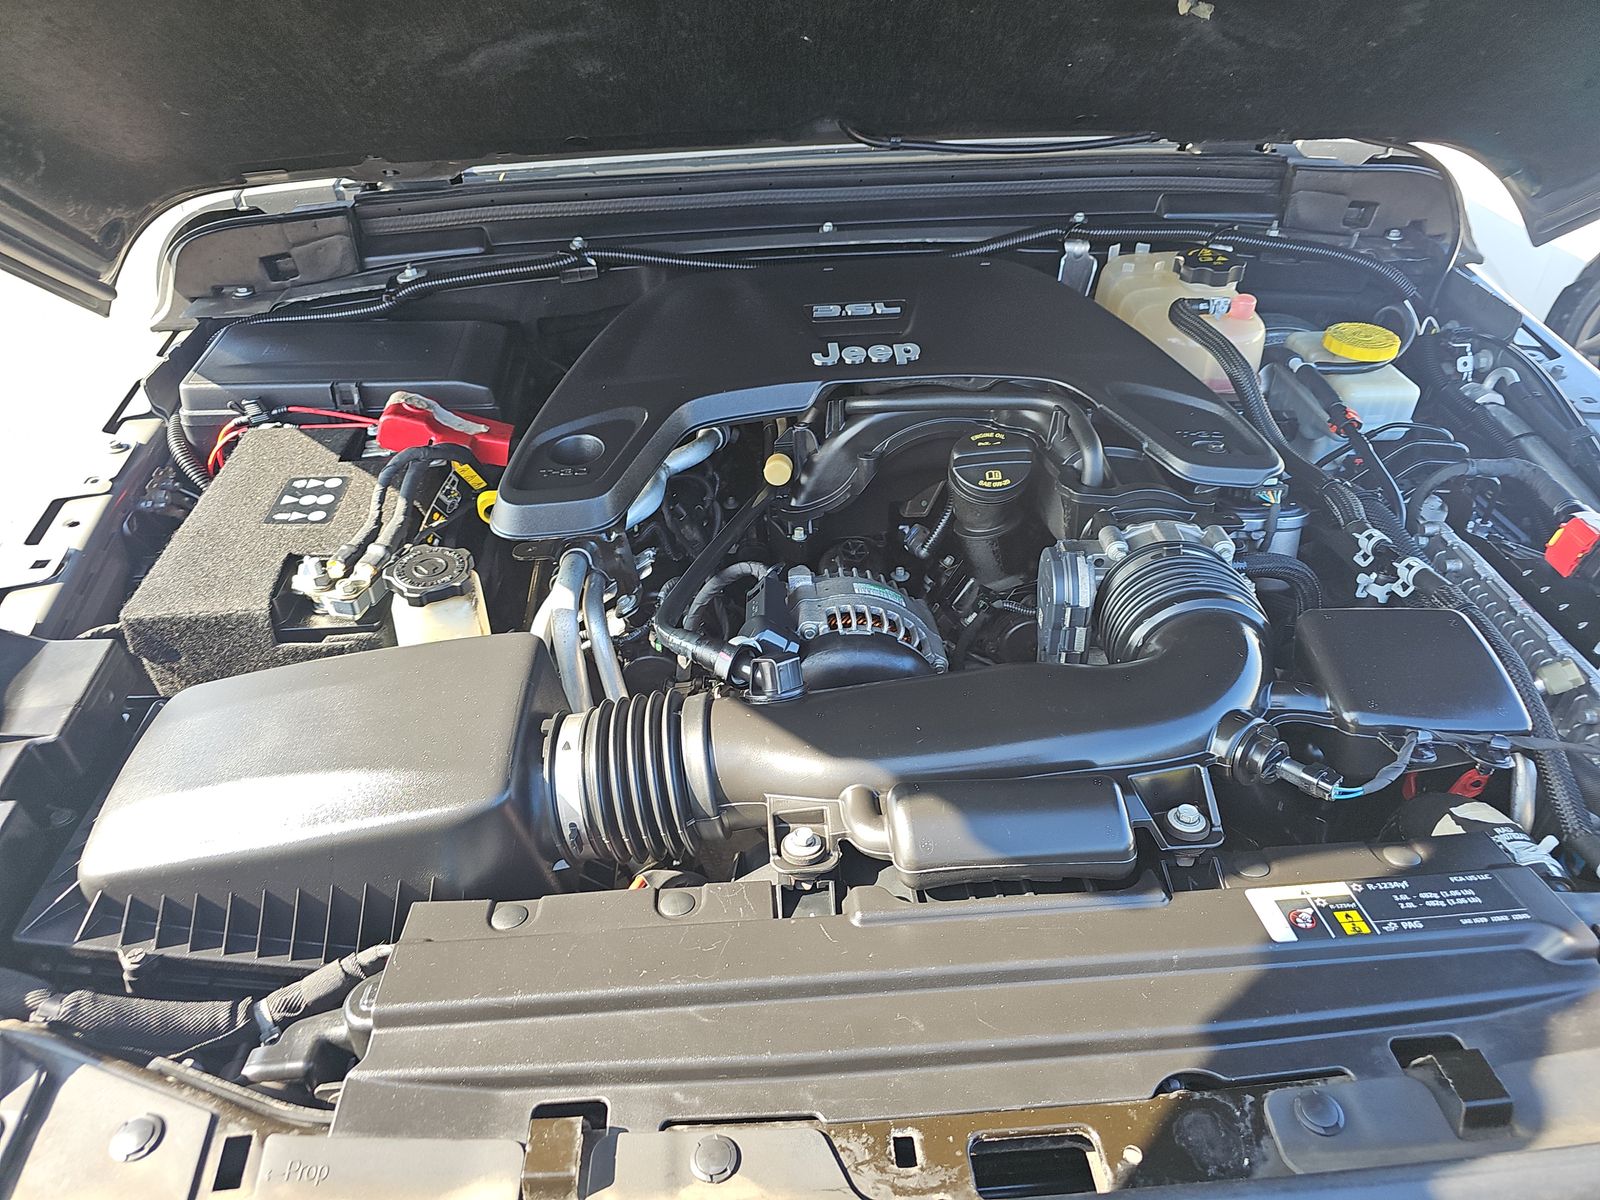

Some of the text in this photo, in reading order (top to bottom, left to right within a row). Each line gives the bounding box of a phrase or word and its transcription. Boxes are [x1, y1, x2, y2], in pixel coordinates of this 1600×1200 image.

[812, 302, 901, 318] 3.6L
[811, 342, 921, 366] Jeep
[994, 432, 1006, 440] OIL
[1366, 881, 1410, 891] R-1234yf
[1400, 920, 1424, 930] PAG
[284, 1160, 330, 1187] Prop
